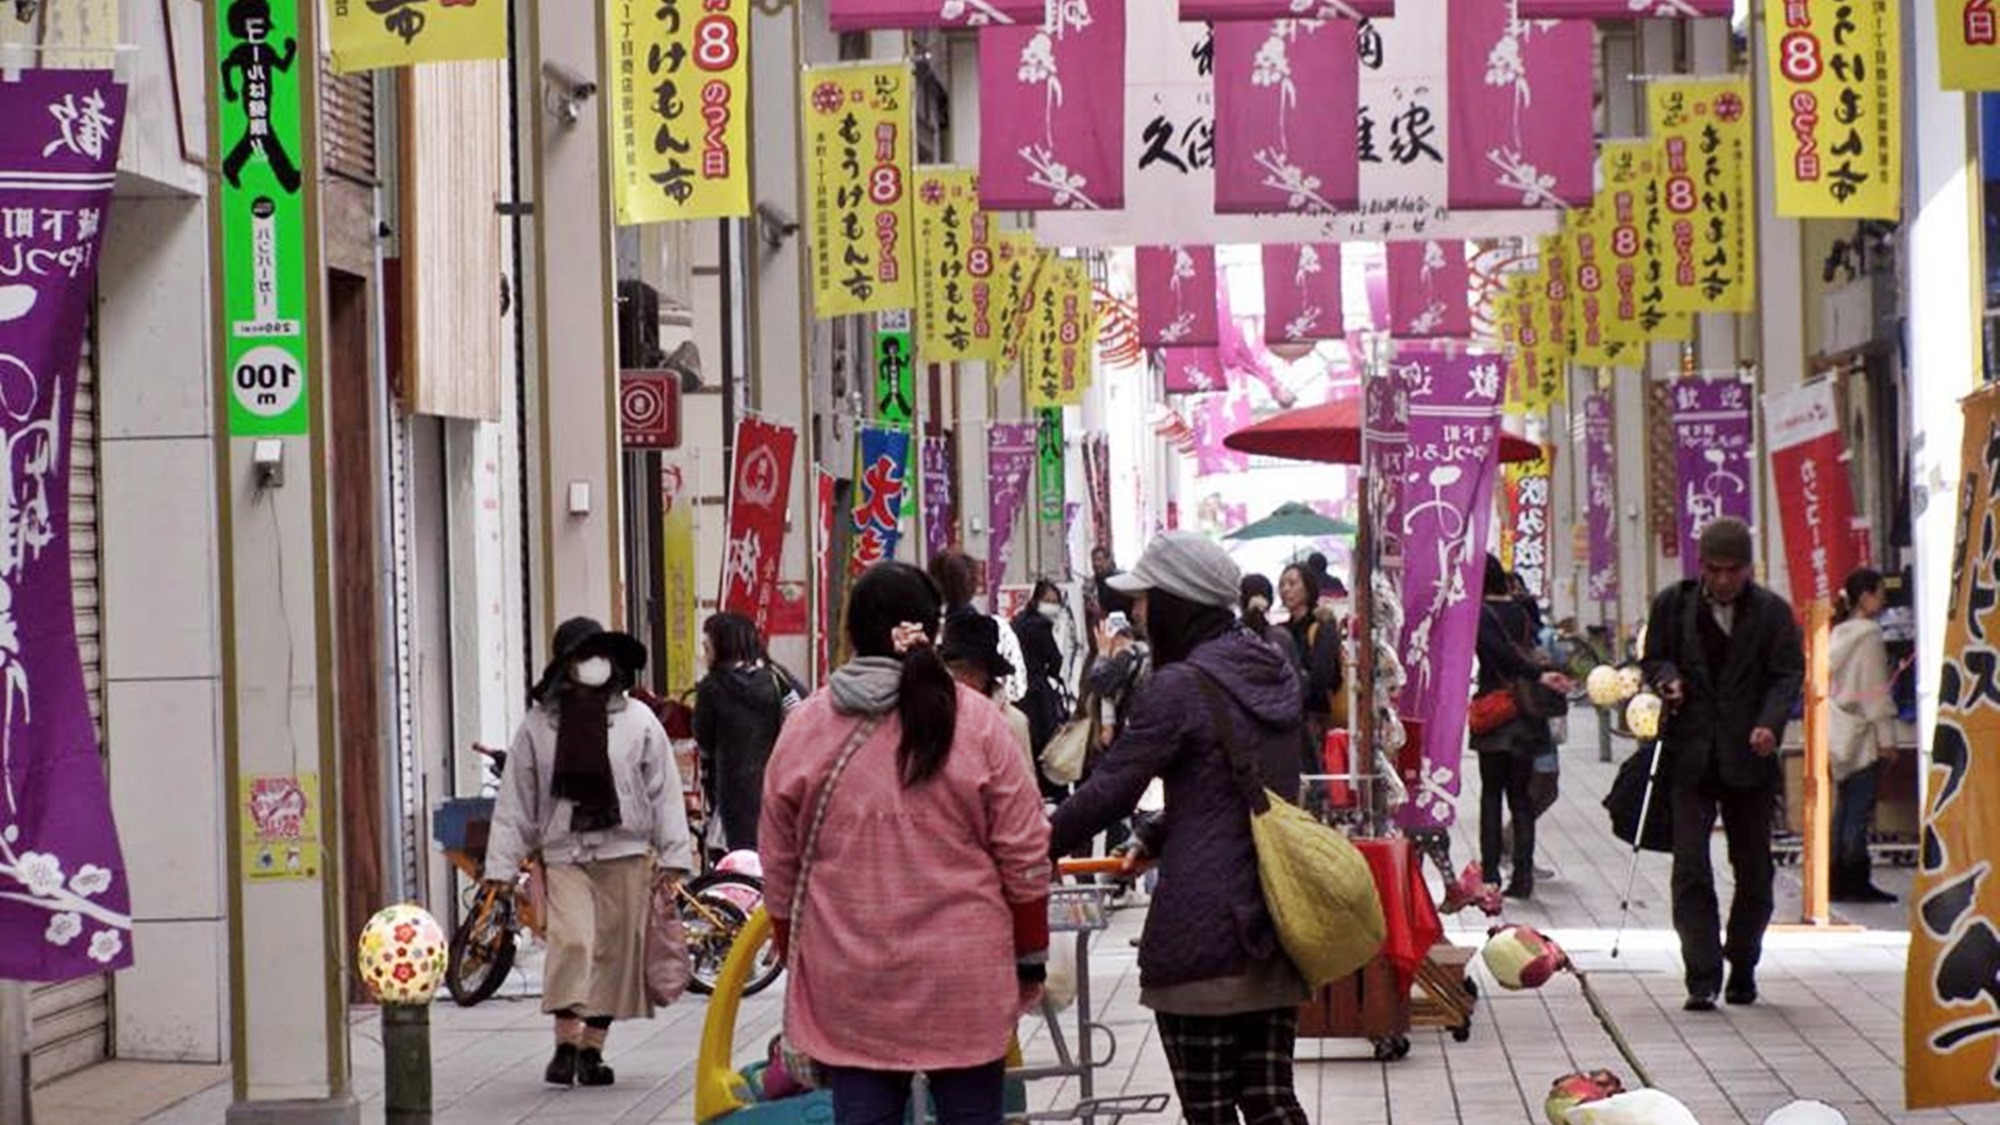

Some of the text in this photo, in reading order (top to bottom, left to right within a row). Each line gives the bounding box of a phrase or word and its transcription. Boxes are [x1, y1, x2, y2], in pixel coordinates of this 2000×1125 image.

[837, 111, 874, 303] もうけもん市
[940, 204, 972, 352] もうけもん市
